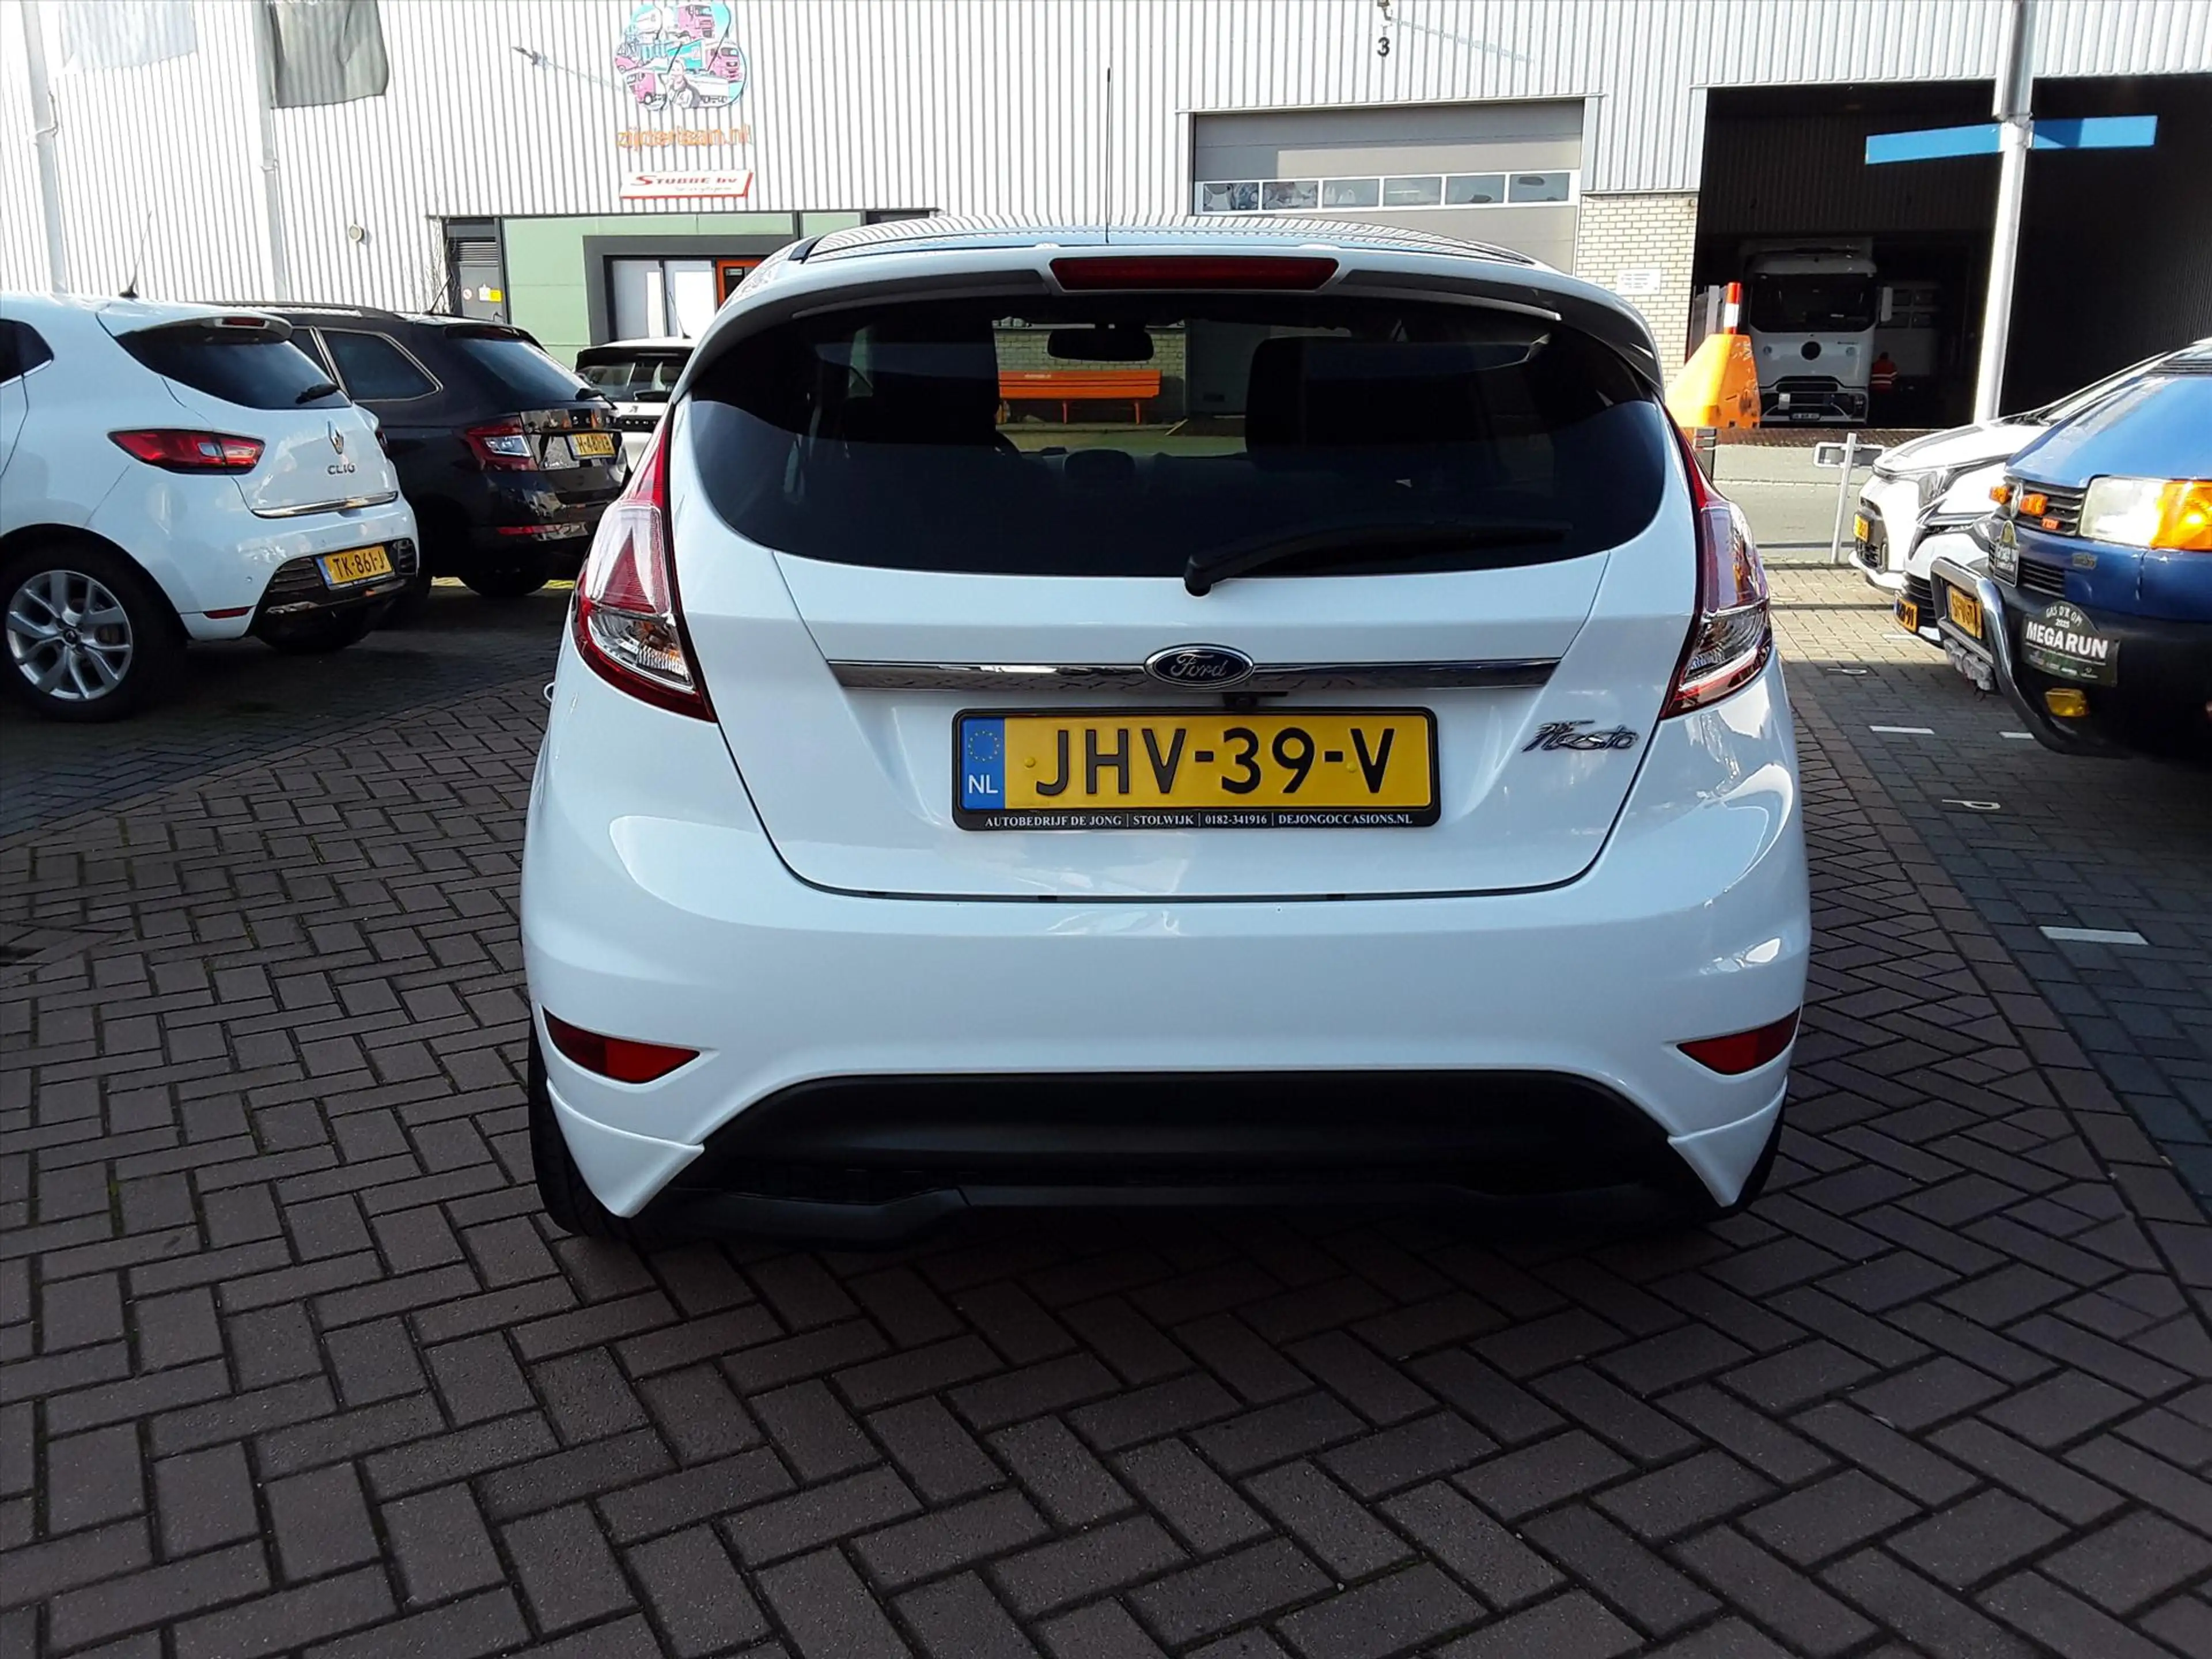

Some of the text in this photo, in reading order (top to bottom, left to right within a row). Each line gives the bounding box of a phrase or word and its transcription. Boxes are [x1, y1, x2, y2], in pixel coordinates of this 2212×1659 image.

[1377, 37, 1390, 57] 3
[327, 464, 355, 475] CLIO
[332, 550, 385, 578] TK-861-J
[1170, 653, 1228, 677] Ford
[1521, 719, 1639, 752] Fiesta
[1036, 727, 1395, 796] JHV-39-V
[968, 774, 998, 794] NL
[985, 815, 1413, 827] AUTOBEDRIJF DE JONG STOLWIJK 0182-341916 DEJONGOCCASIONS.NL
